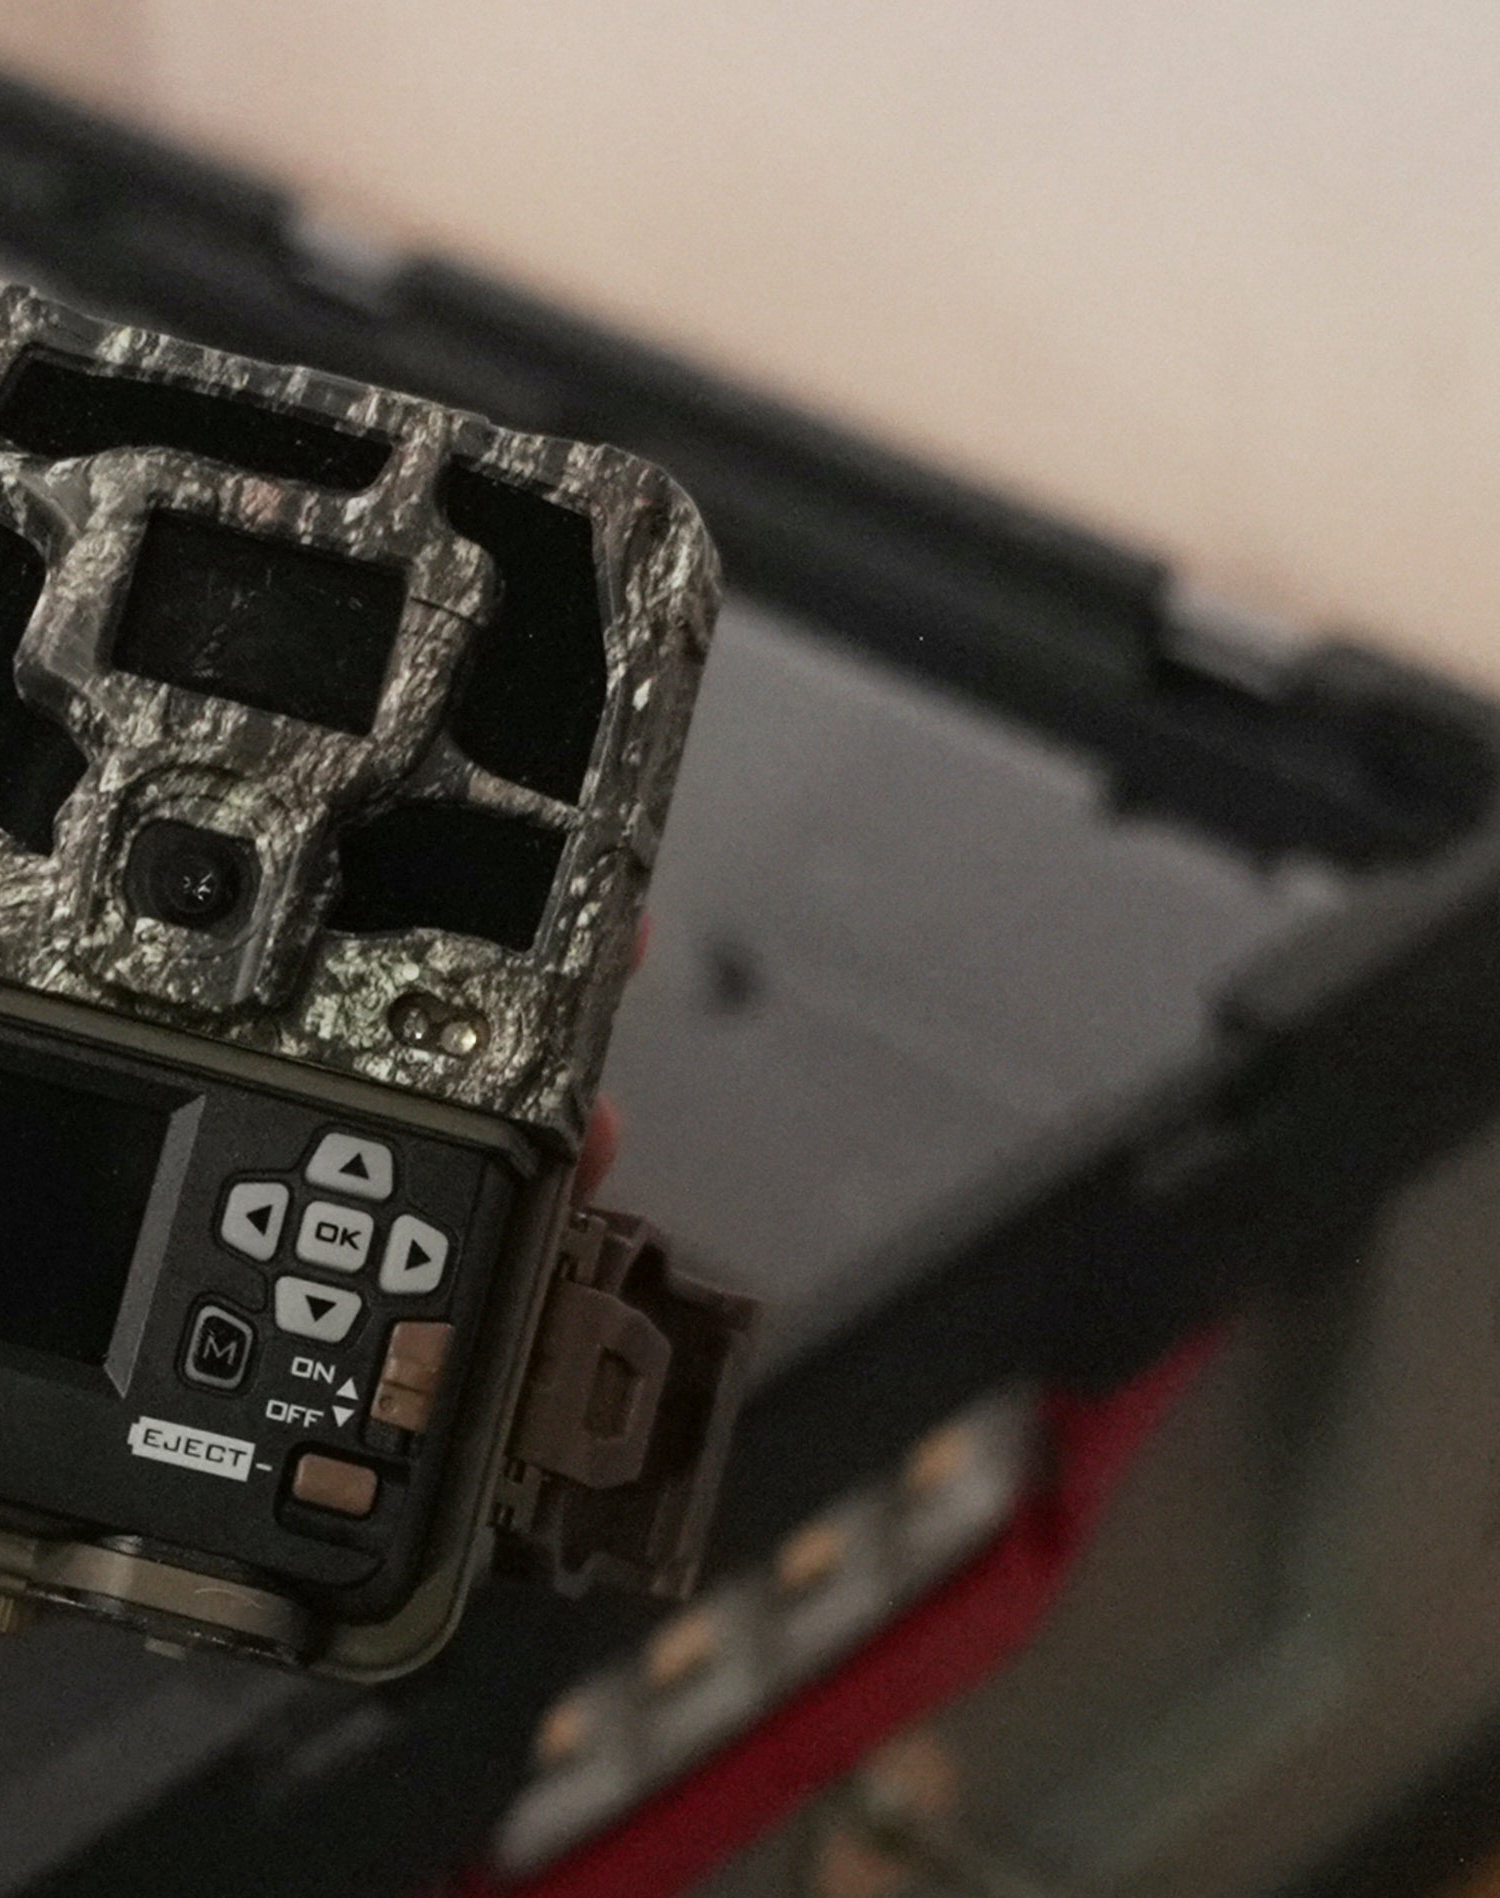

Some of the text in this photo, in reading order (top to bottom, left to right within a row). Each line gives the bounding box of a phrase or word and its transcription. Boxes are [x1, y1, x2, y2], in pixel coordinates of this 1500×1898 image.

[315, 1221, 361, 1250] OK
[202, 1332, 238, 1365] M
[290, 1356, 336, 1384] ON
[265, 1399, 324, 1428] OFF
[143, 1428, 247, 1467] EJECT
